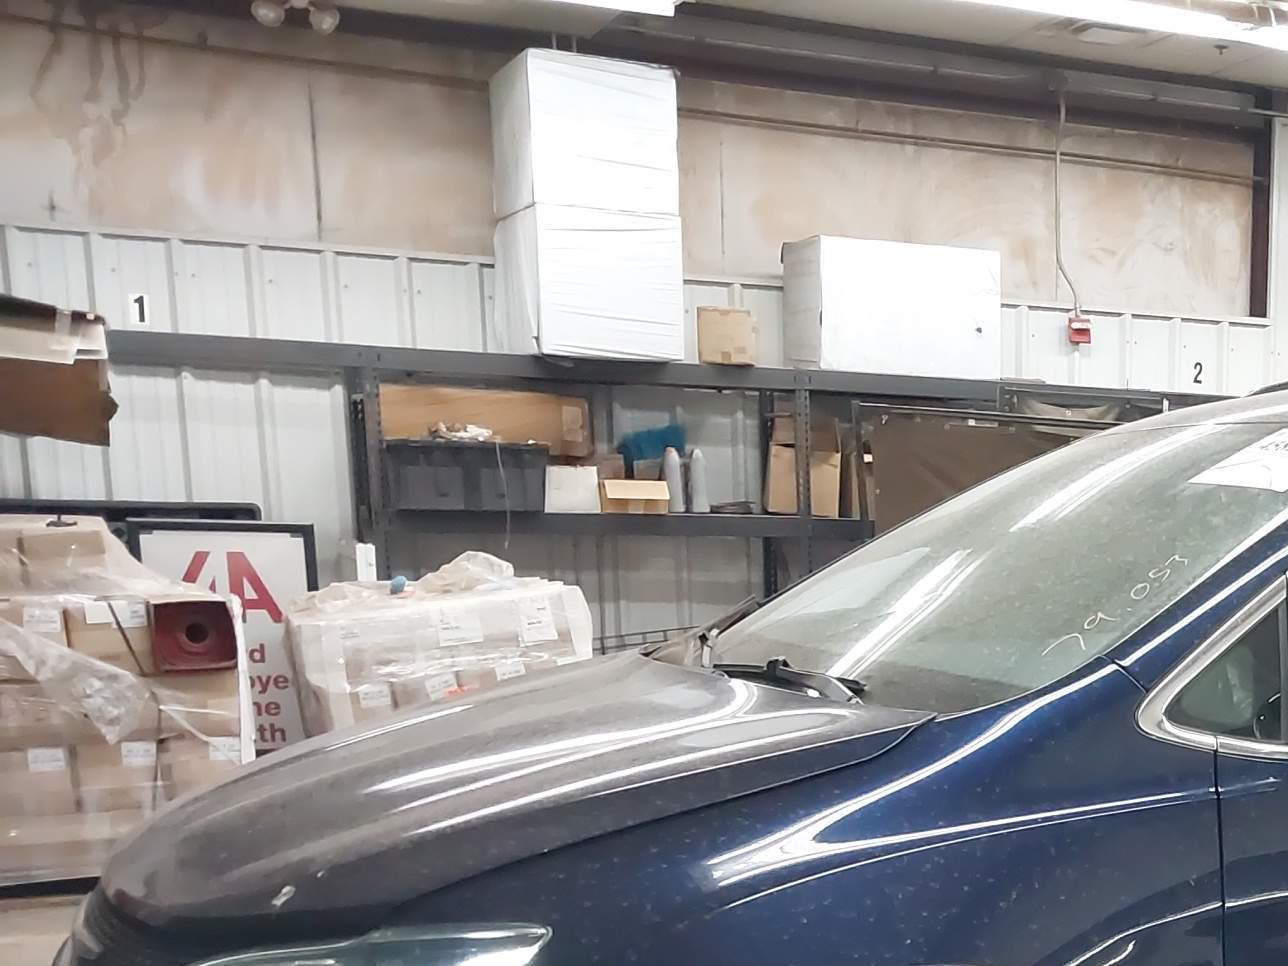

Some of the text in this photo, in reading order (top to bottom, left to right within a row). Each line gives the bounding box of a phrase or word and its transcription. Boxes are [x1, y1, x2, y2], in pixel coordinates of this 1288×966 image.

[133, 295, 146, 323] 1
[1193, 361, 1204, 384] 2
[256, 723, 287, 743] th
